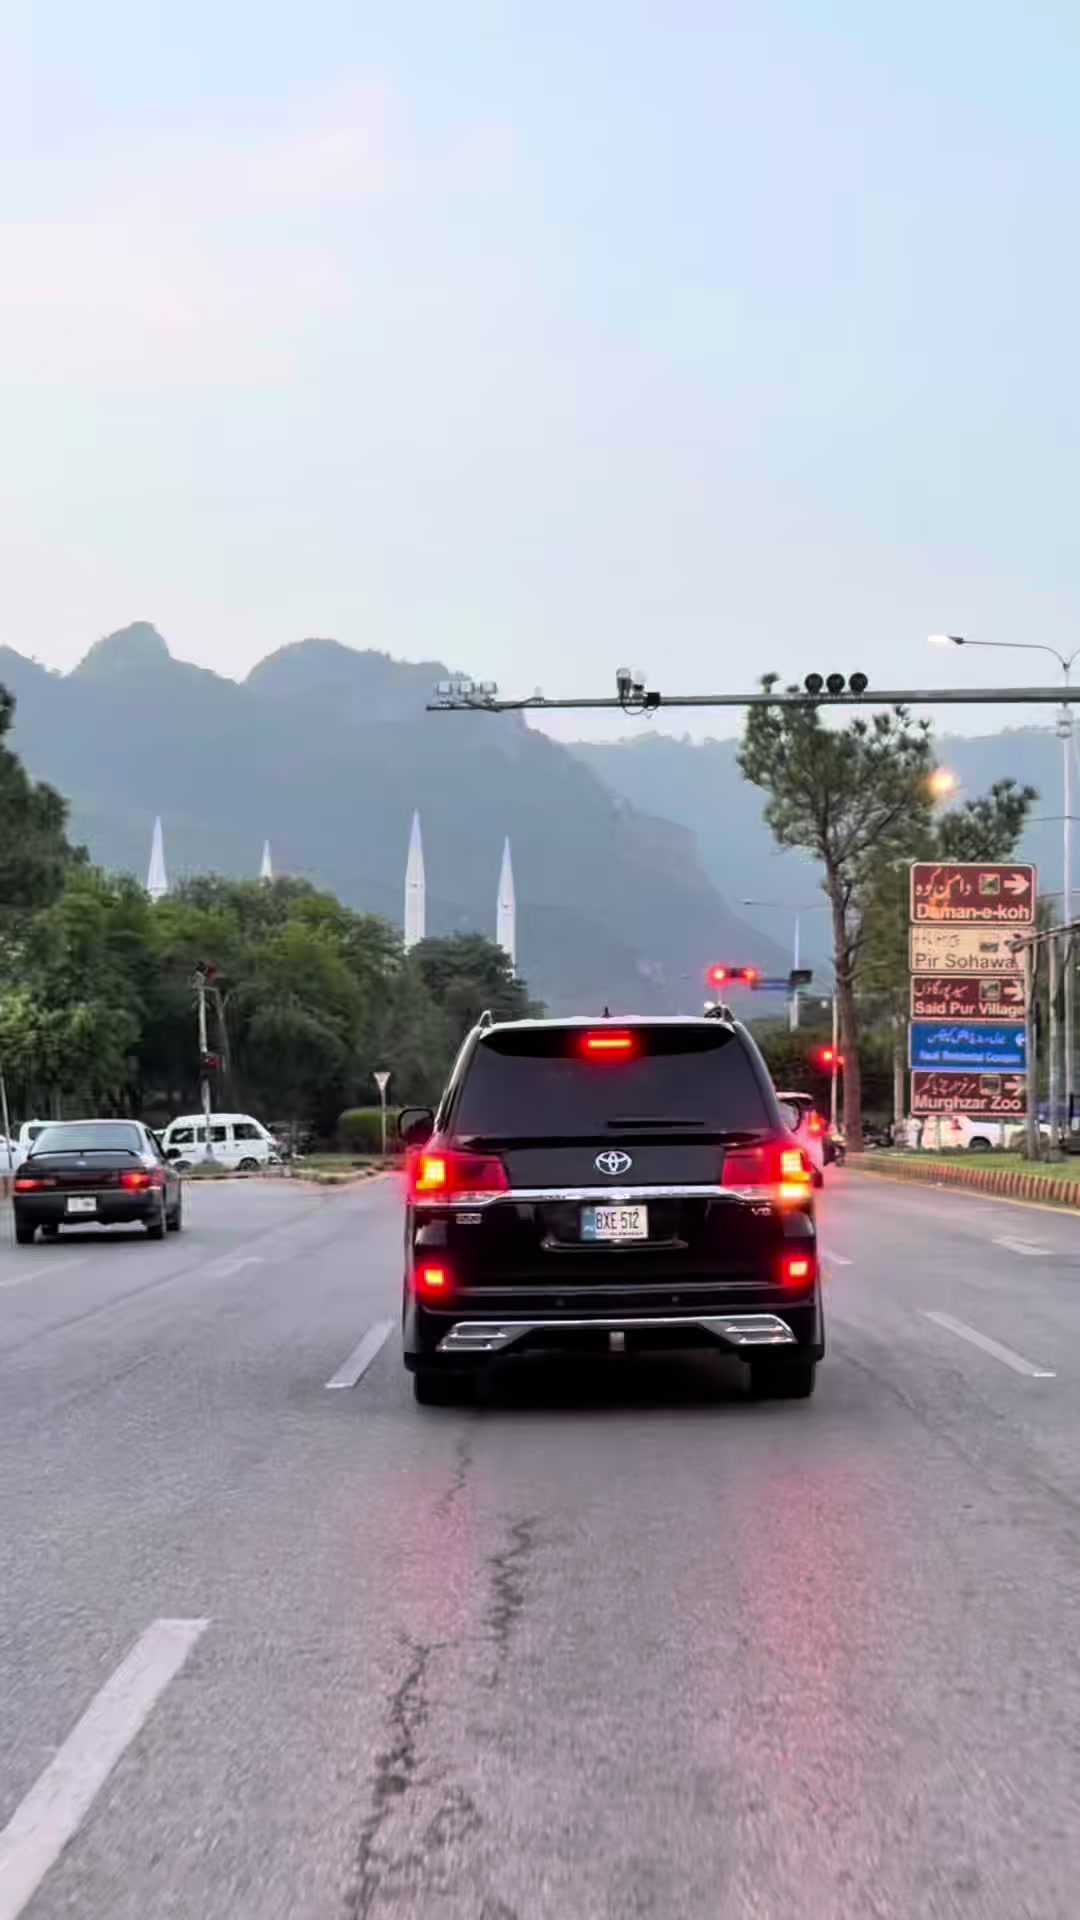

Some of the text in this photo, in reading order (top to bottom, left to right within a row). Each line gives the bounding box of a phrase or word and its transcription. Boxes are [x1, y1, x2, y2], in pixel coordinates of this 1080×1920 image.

[915, 953, 1017, 968] Pir Sohawa
[915, 1002, 946, 1014] Said
[950, 1002, 976, 1014] Pur
[914, 1094, 1022, 1112] Murghzar Zoo
[595, 1211, 640, 1230] BXE 512
